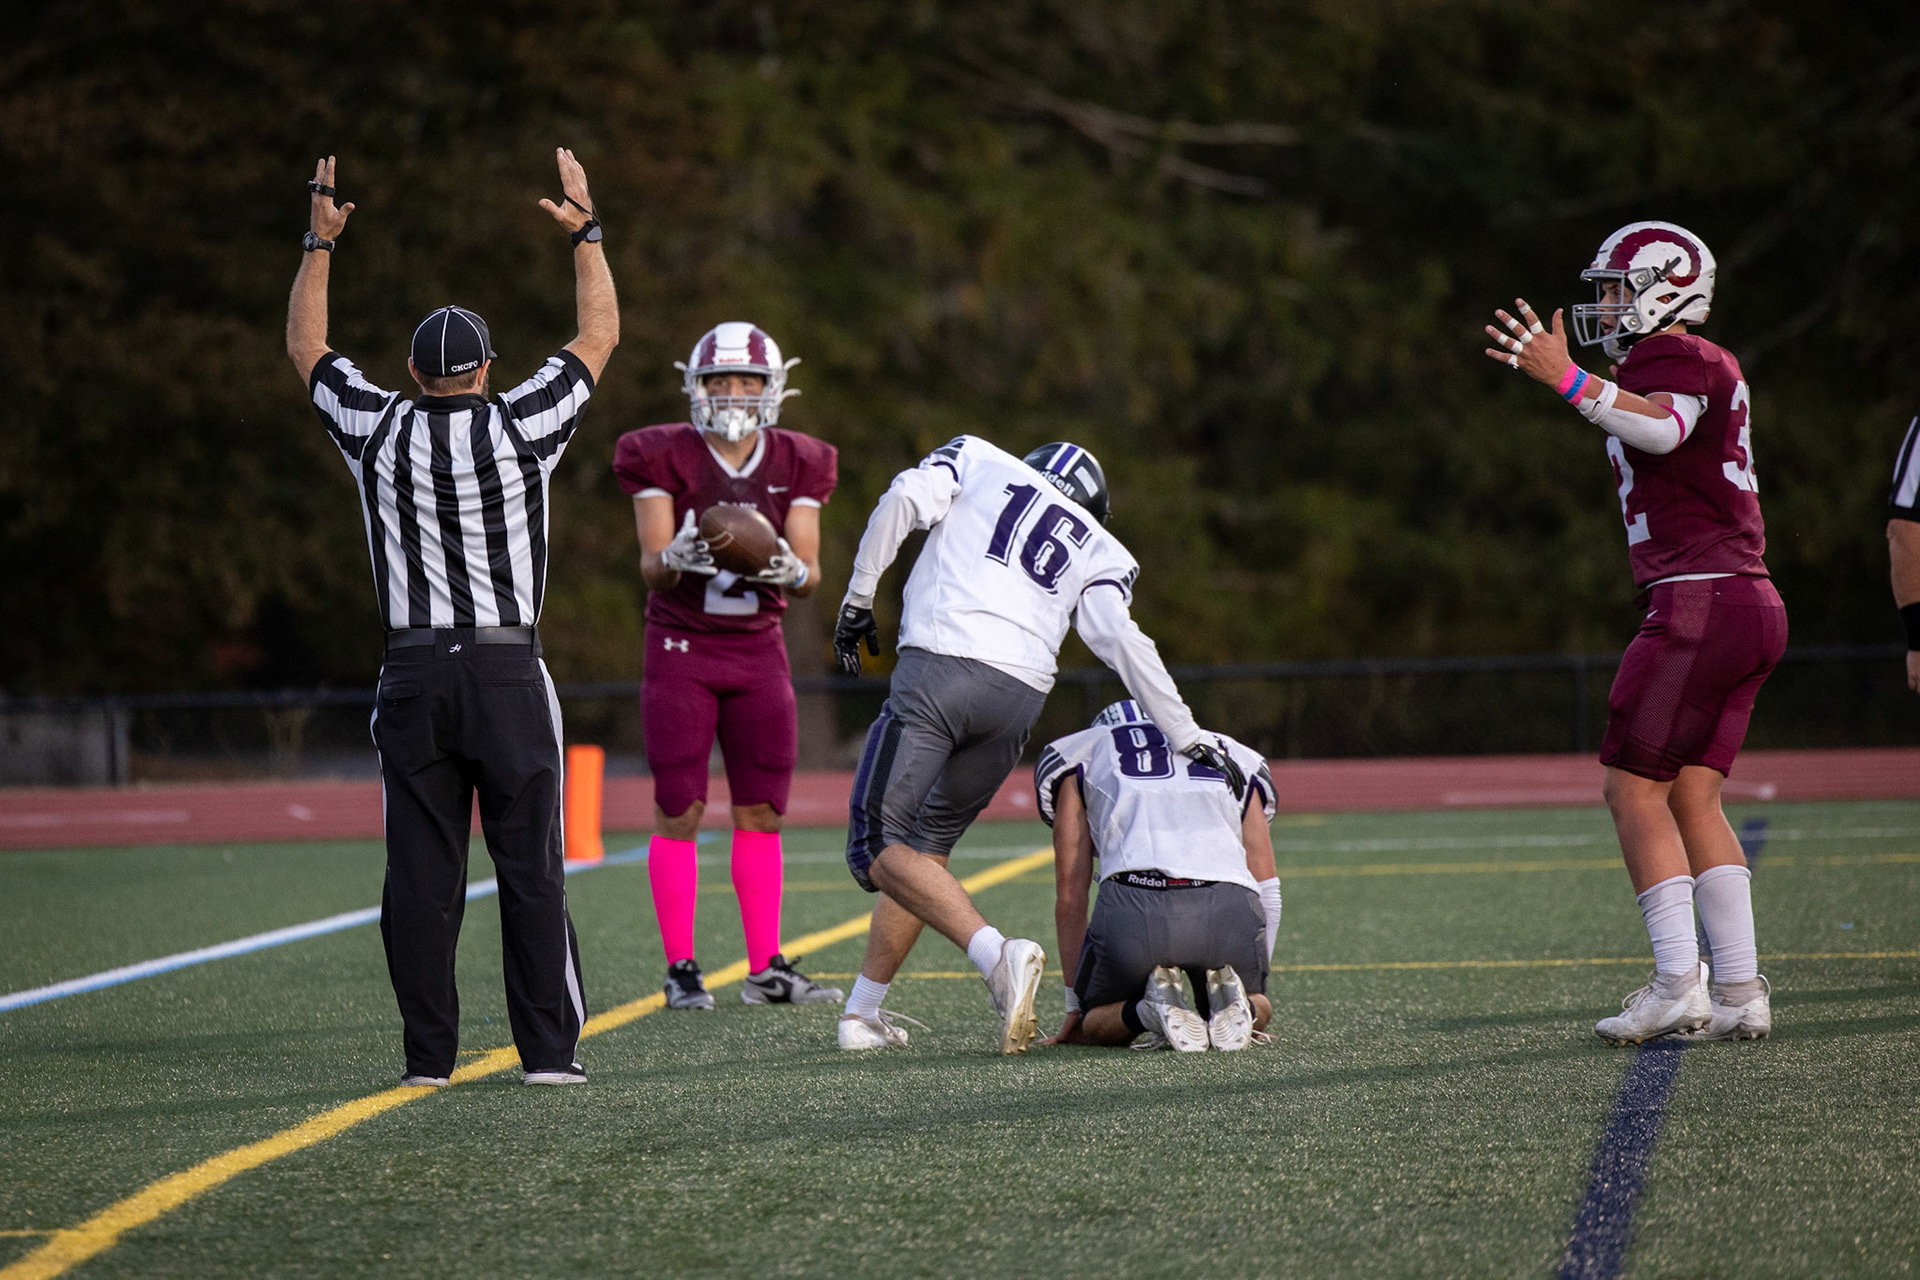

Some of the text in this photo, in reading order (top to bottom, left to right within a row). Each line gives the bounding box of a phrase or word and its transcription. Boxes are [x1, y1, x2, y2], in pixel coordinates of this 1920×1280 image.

[1038, 470, 1076, 497] ddell
[1722, 380, 1759, 493] 3
[984, 482, 1093, 595] 16
